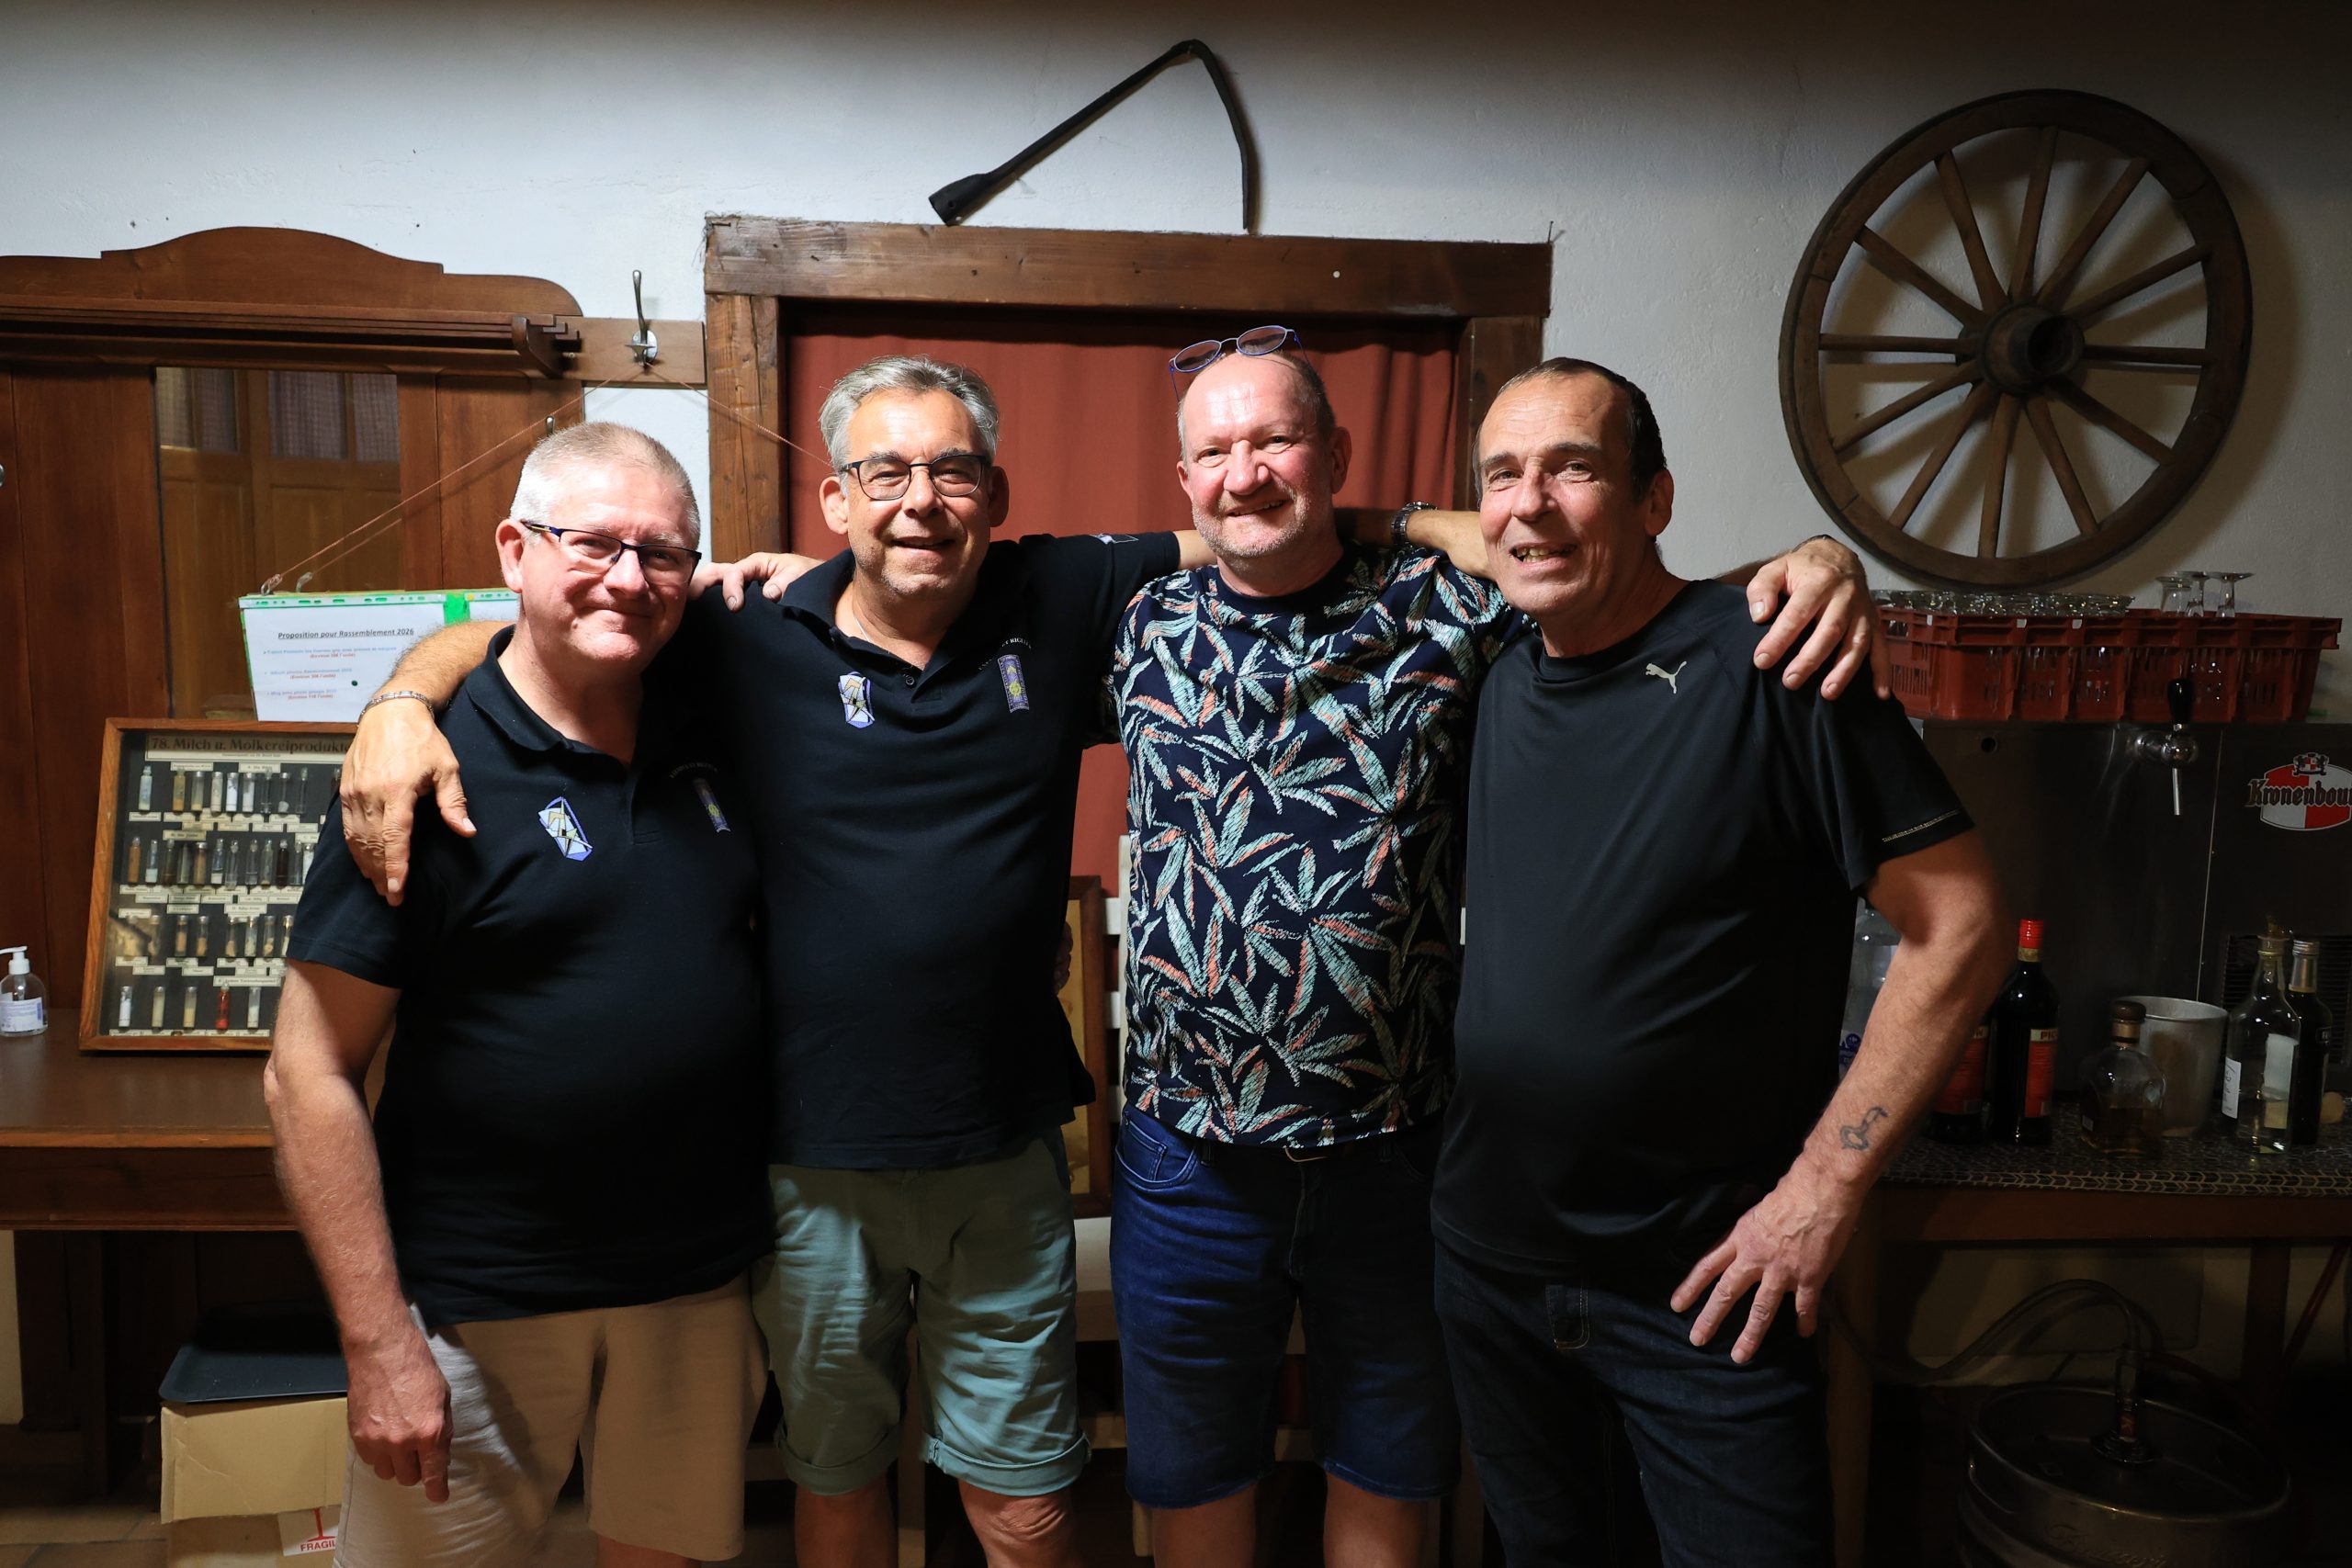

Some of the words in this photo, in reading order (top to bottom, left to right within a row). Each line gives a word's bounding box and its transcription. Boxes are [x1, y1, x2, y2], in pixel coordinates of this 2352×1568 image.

[278, 632, 319, 640] Proposition
[339, 629, 395, 637] Rassemblement
[152, 738, 170, 750] 78.
[174, 736, 211, 750] Milch
[215, 739, 226, 750] u.
